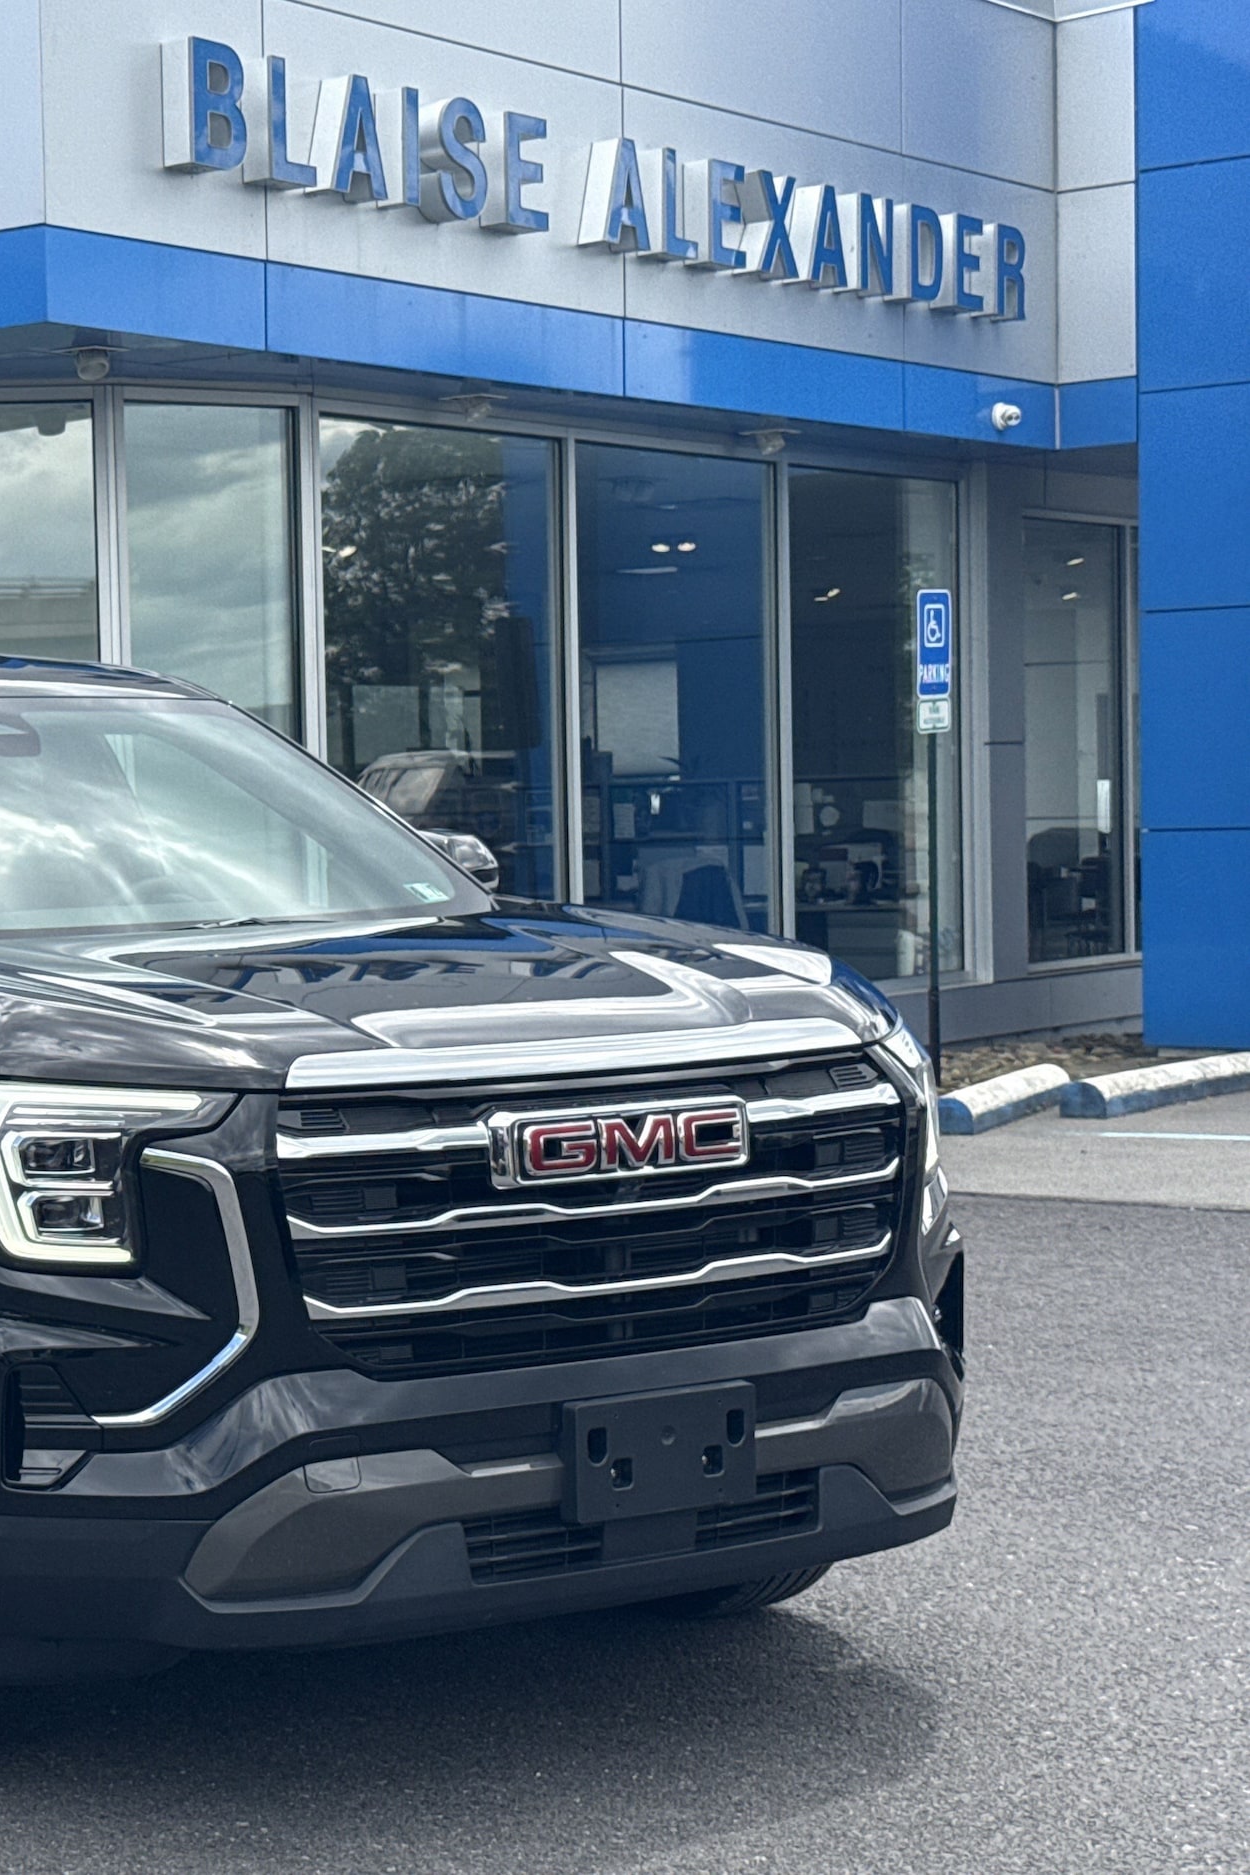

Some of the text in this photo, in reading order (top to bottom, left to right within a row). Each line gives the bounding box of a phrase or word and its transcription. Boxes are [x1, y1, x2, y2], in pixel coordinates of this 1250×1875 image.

[190, 36, 1027, 321] BLAISE ALEXANDER
[919, 663, 950, 683] PARKING
[523, 1108, 743, 1176] GMC
